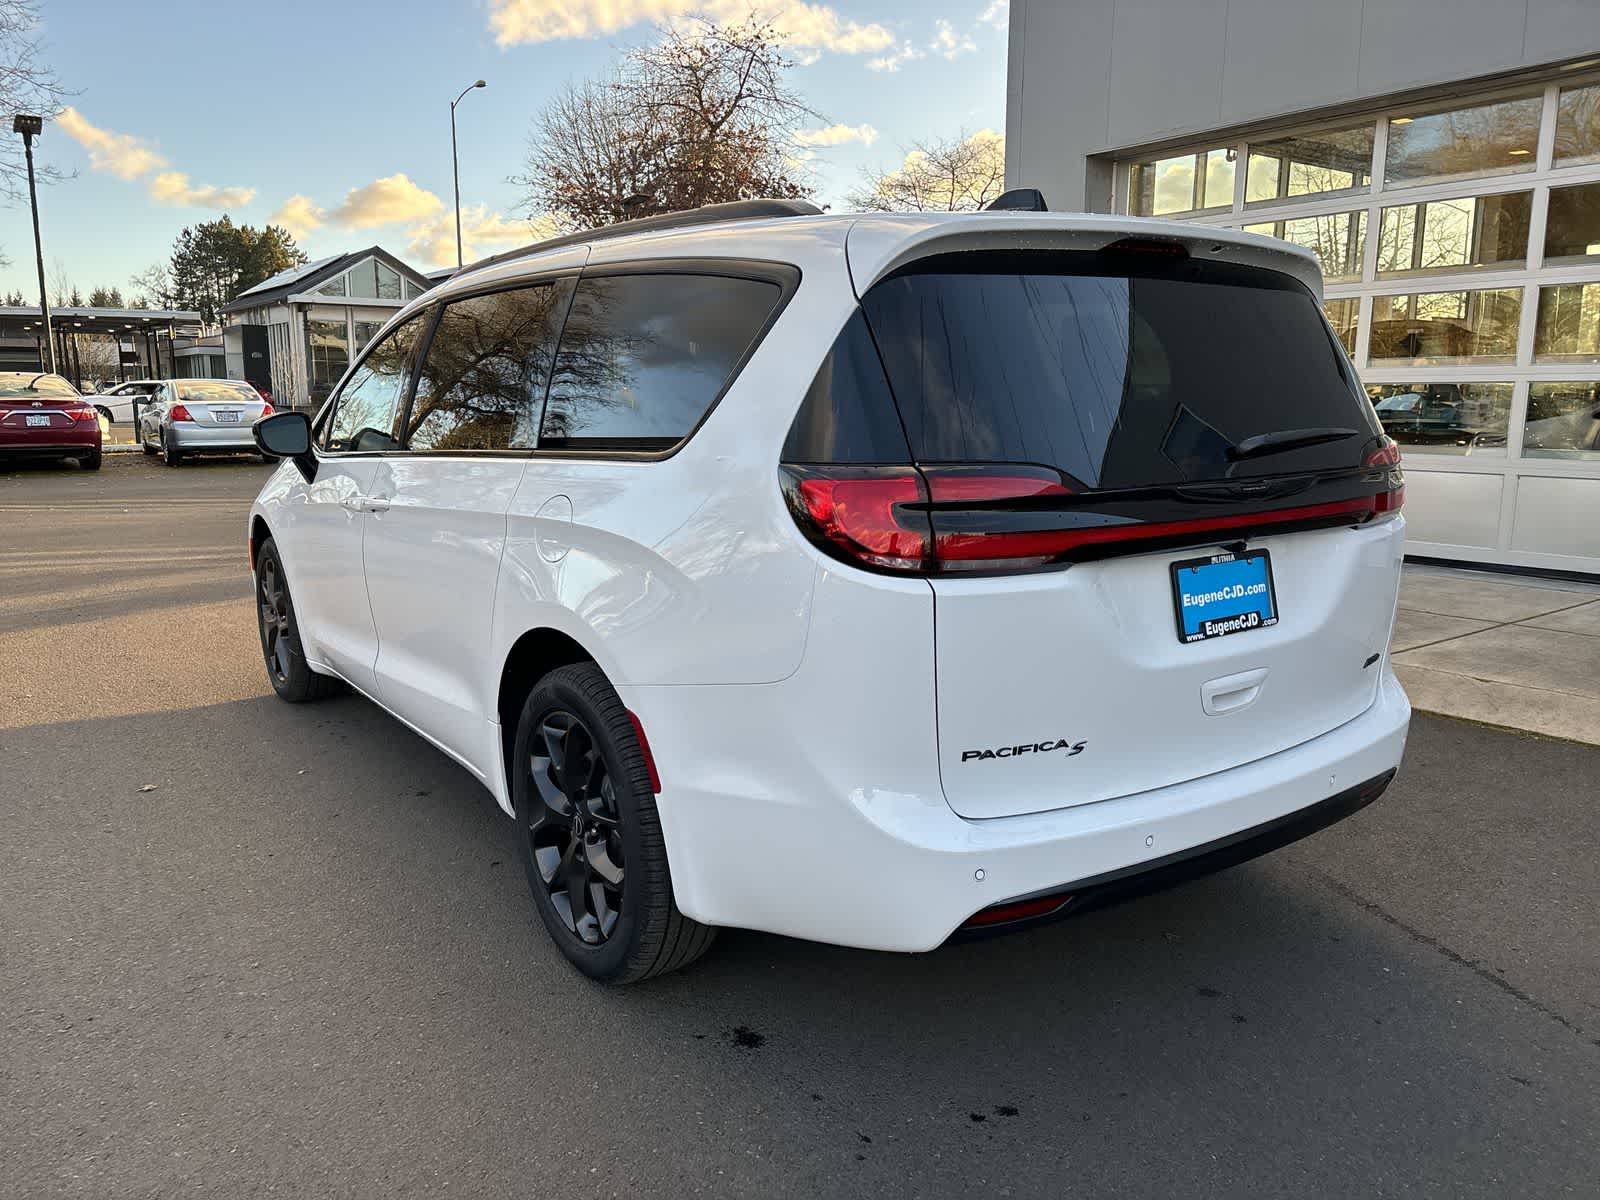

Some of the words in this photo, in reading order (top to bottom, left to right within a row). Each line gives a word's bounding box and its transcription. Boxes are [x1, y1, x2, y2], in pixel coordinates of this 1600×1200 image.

[1183, 583, 1267, 607] EugeneCJD.com
[1205, 612, 1259, 635] EugeneCJD
[961, 739, 1069, 762] PACIFICA
[1067, 740, 1088, 757] S
